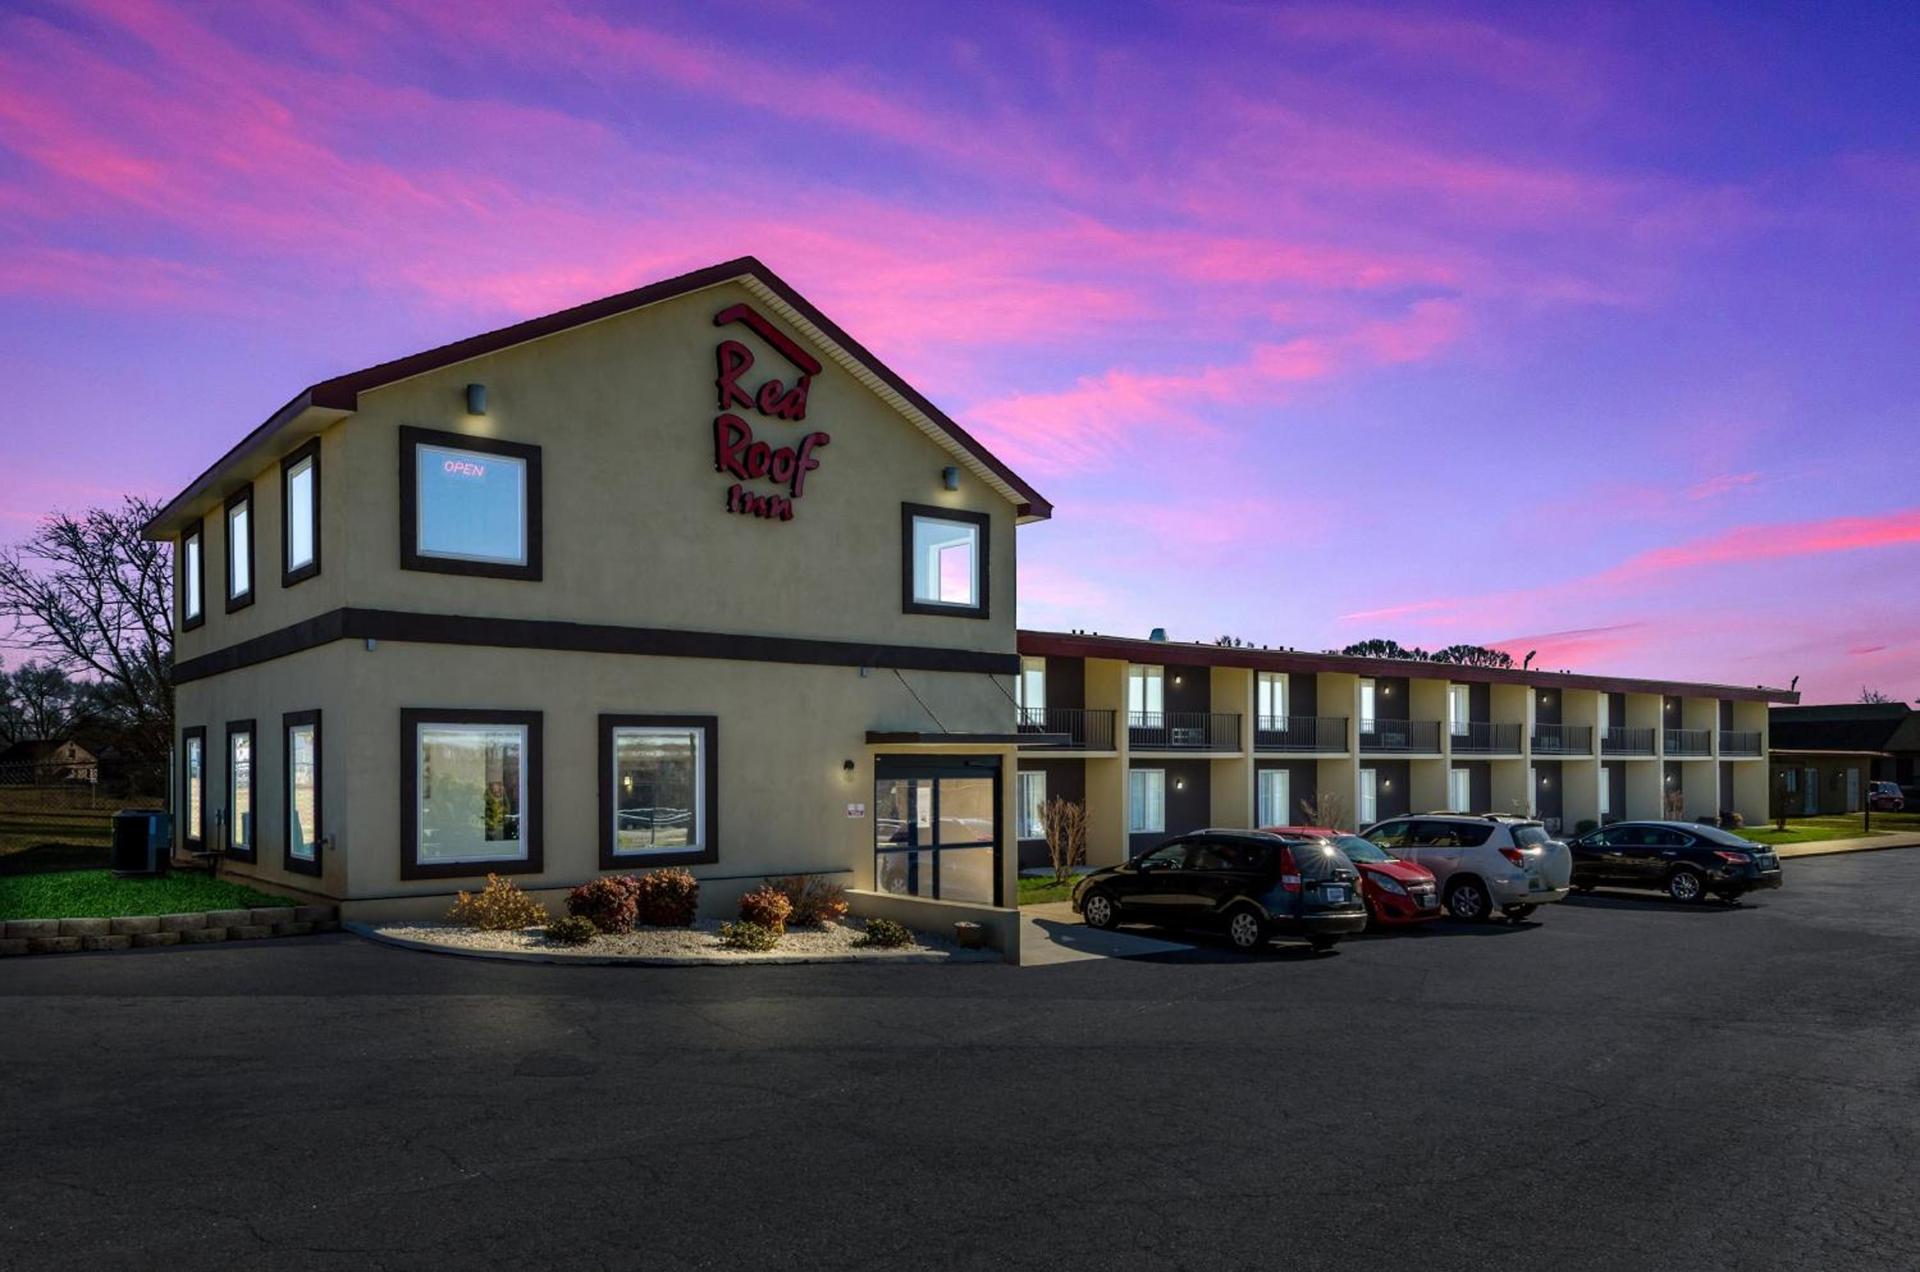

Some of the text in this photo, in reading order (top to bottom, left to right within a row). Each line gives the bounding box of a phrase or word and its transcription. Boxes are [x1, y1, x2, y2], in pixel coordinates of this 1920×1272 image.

[716, 340, 811, 420] Red
[444, 460, 485, 476] OPEN
[713, 413, 830, 497] Roof
[727, 484, 793, 521] Inn
